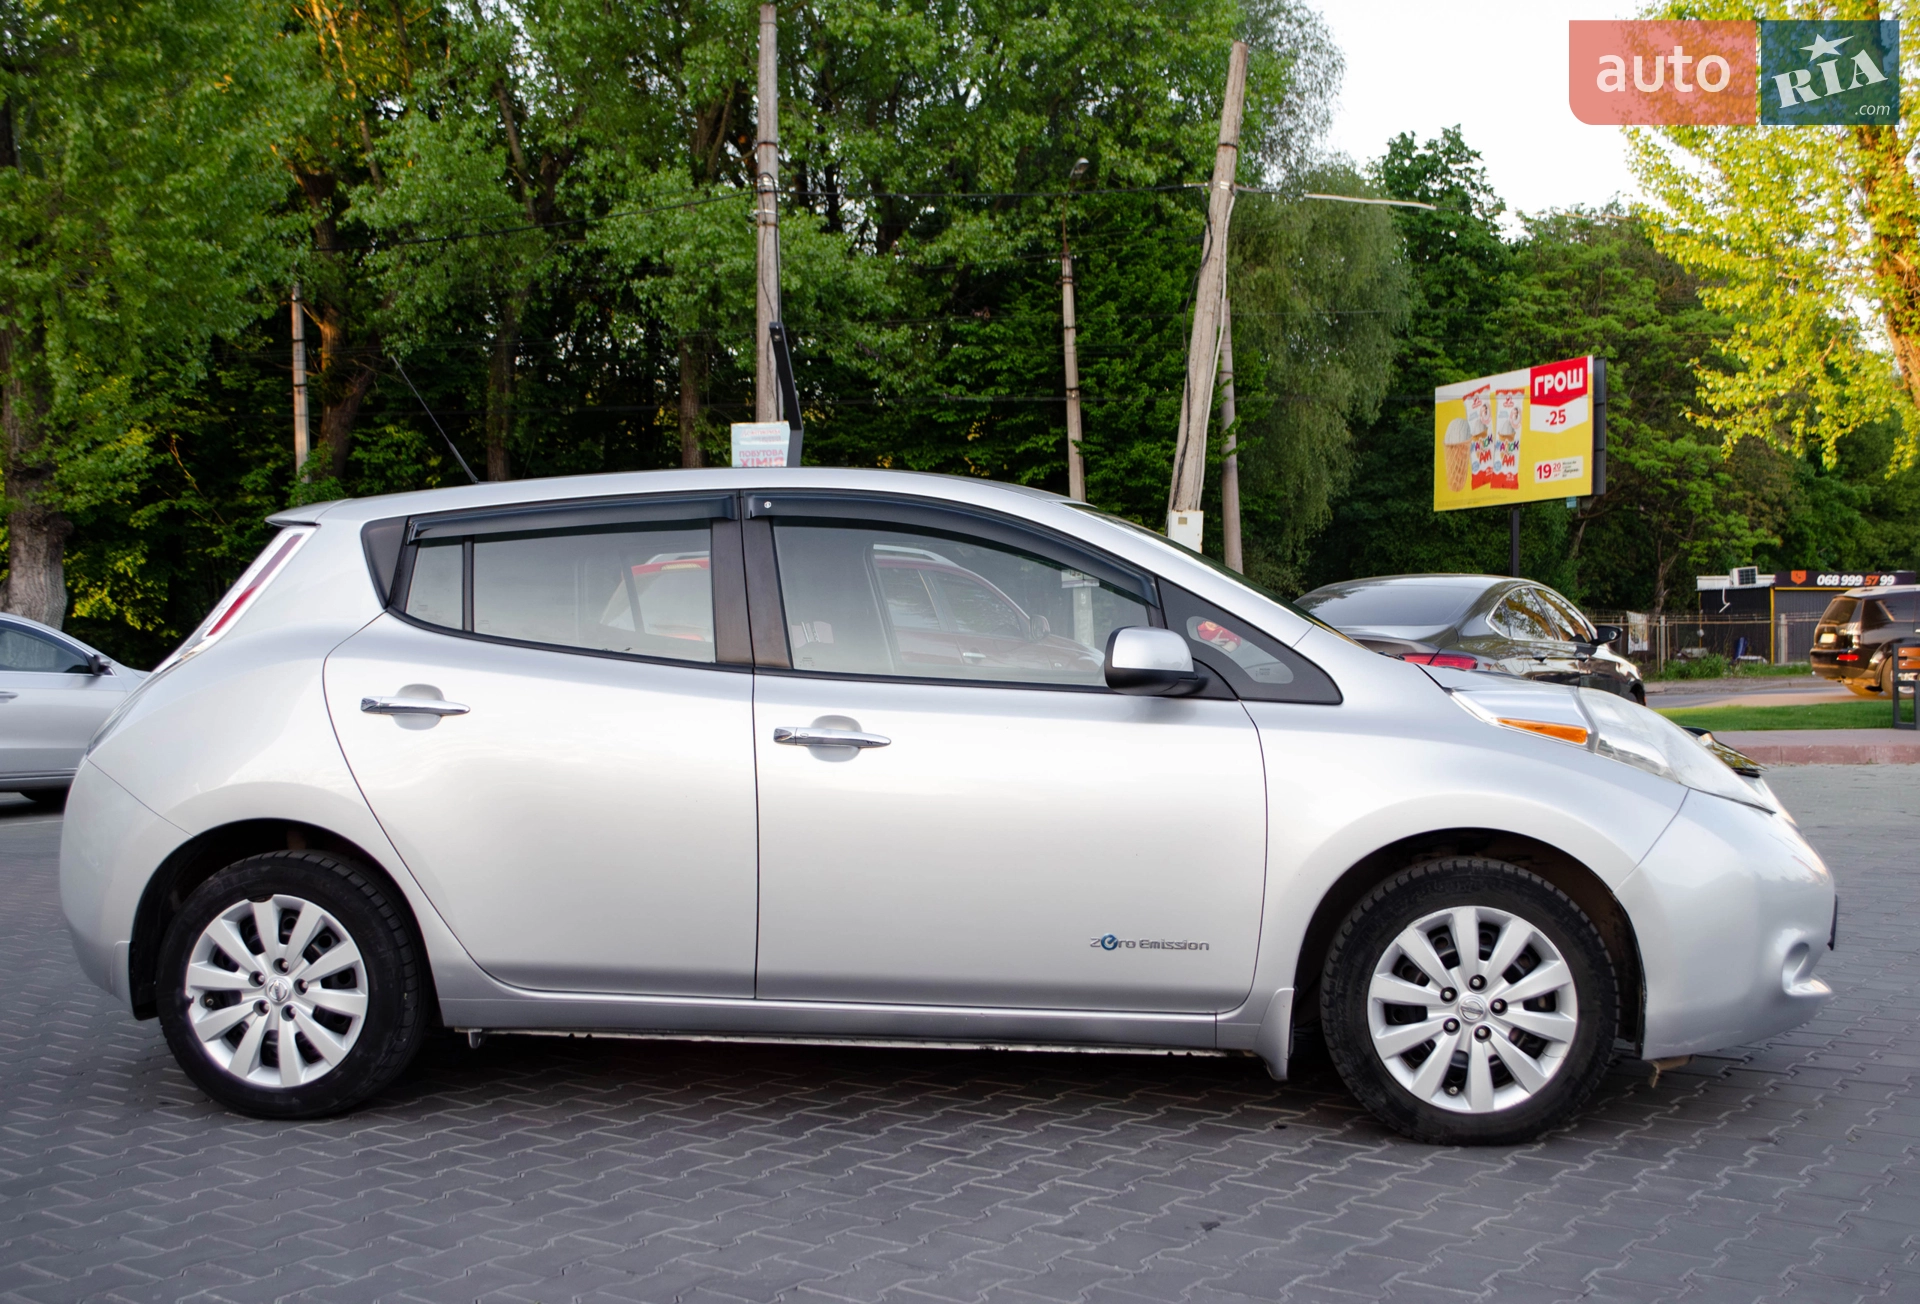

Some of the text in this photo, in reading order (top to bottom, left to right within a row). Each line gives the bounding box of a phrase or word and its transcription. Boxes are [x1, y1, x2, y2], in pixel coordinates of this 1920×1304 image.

[1534, 367, 1583, 397] ГРОШ
[1545, 409, 1566, 426] -25
[1536, 463, 1552, 480] 19
[1817, 574, 1895, 586] 068 999 57 99
[1139, 938, 1210, 951] Emission
